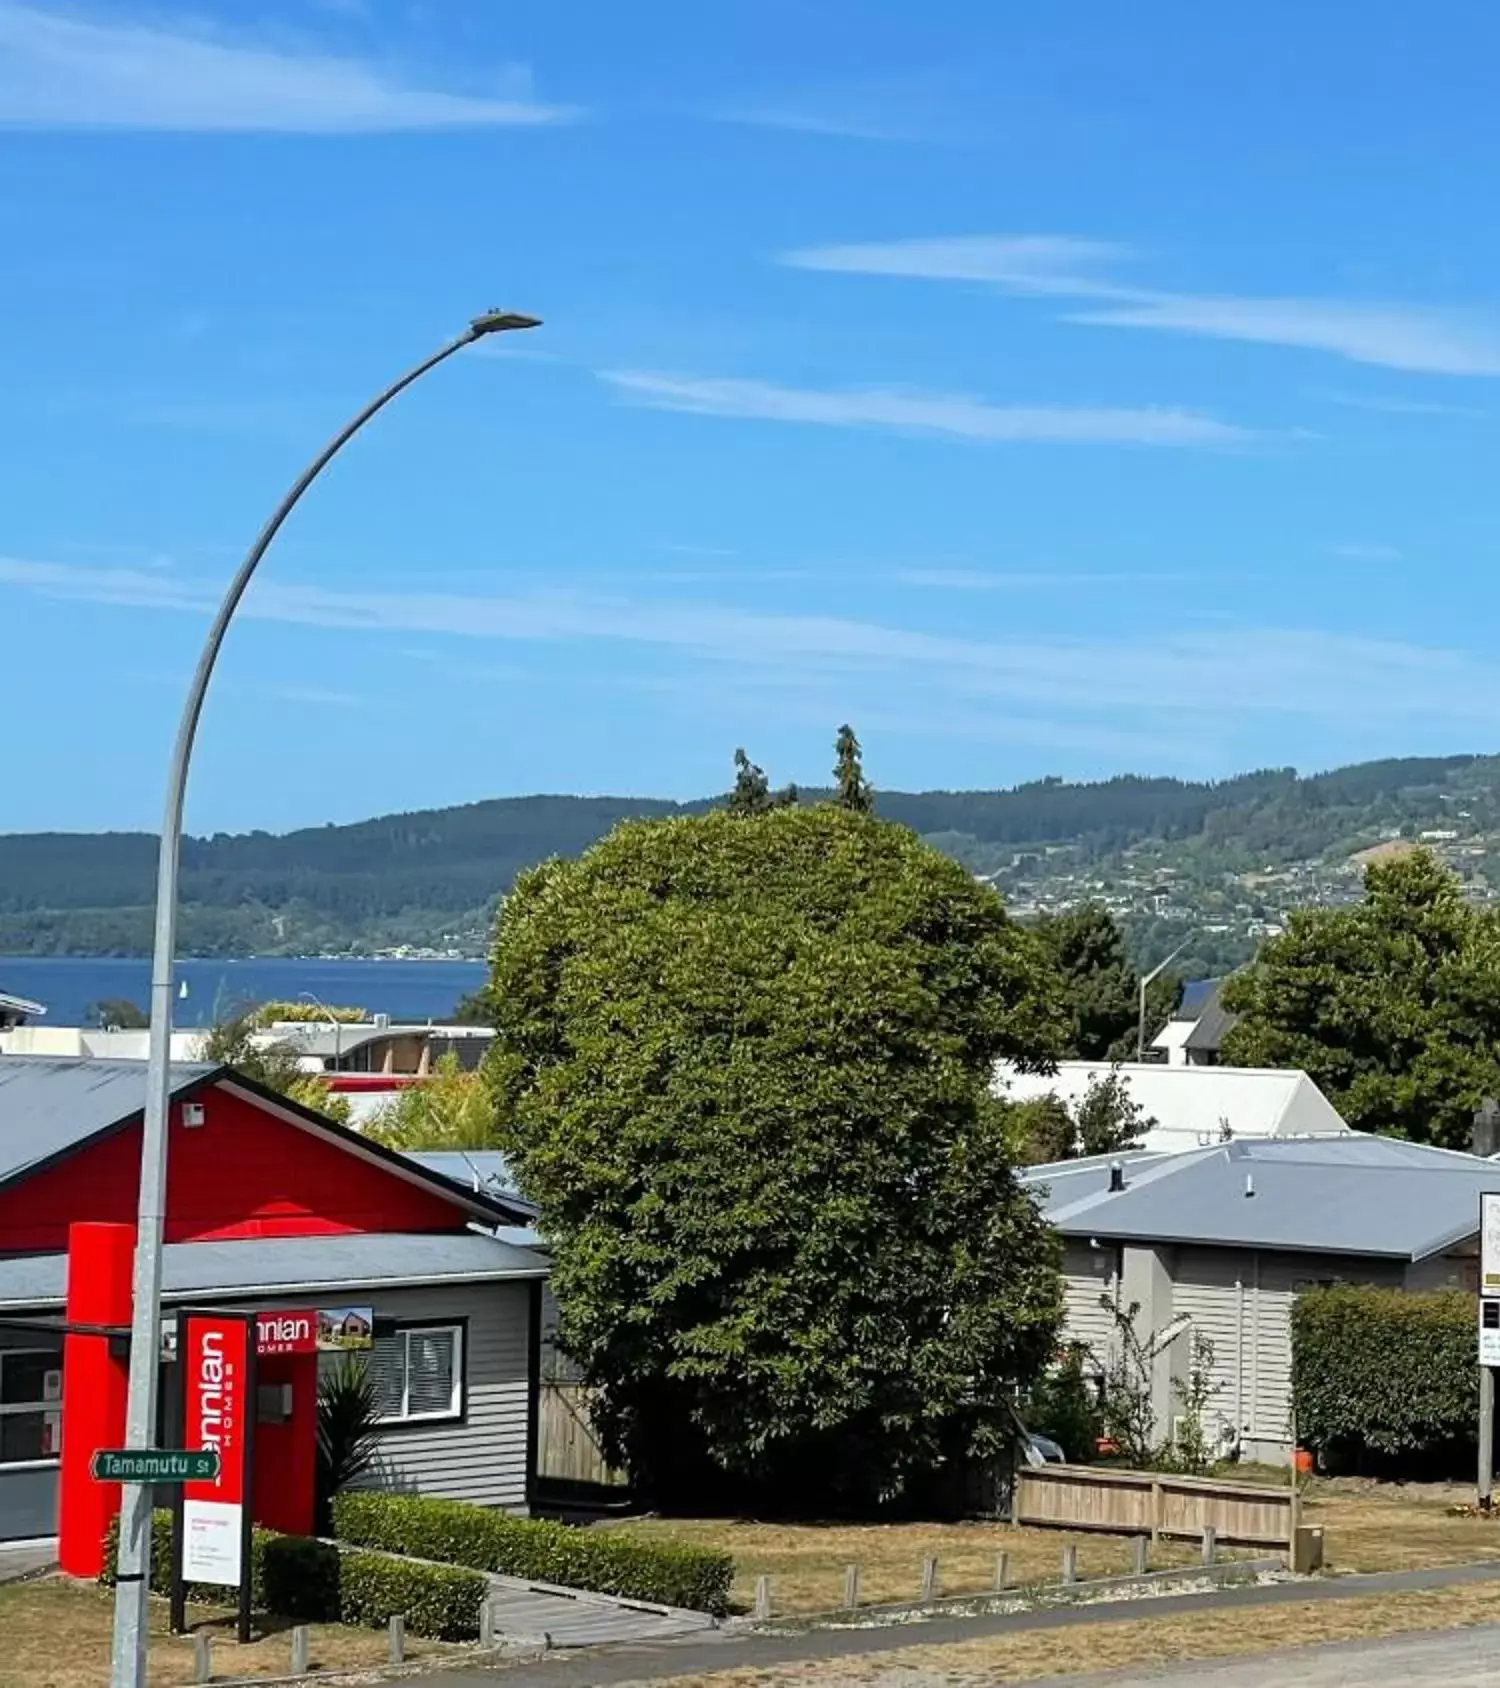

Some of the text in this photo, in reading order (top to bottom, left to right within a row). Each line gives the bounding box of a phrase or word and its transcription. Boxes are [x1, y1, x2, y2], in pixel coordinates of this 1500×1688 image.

[223, 1363, 233, 1446] HOMES
[104, 1454, 209, 1473] Tamamutu St
